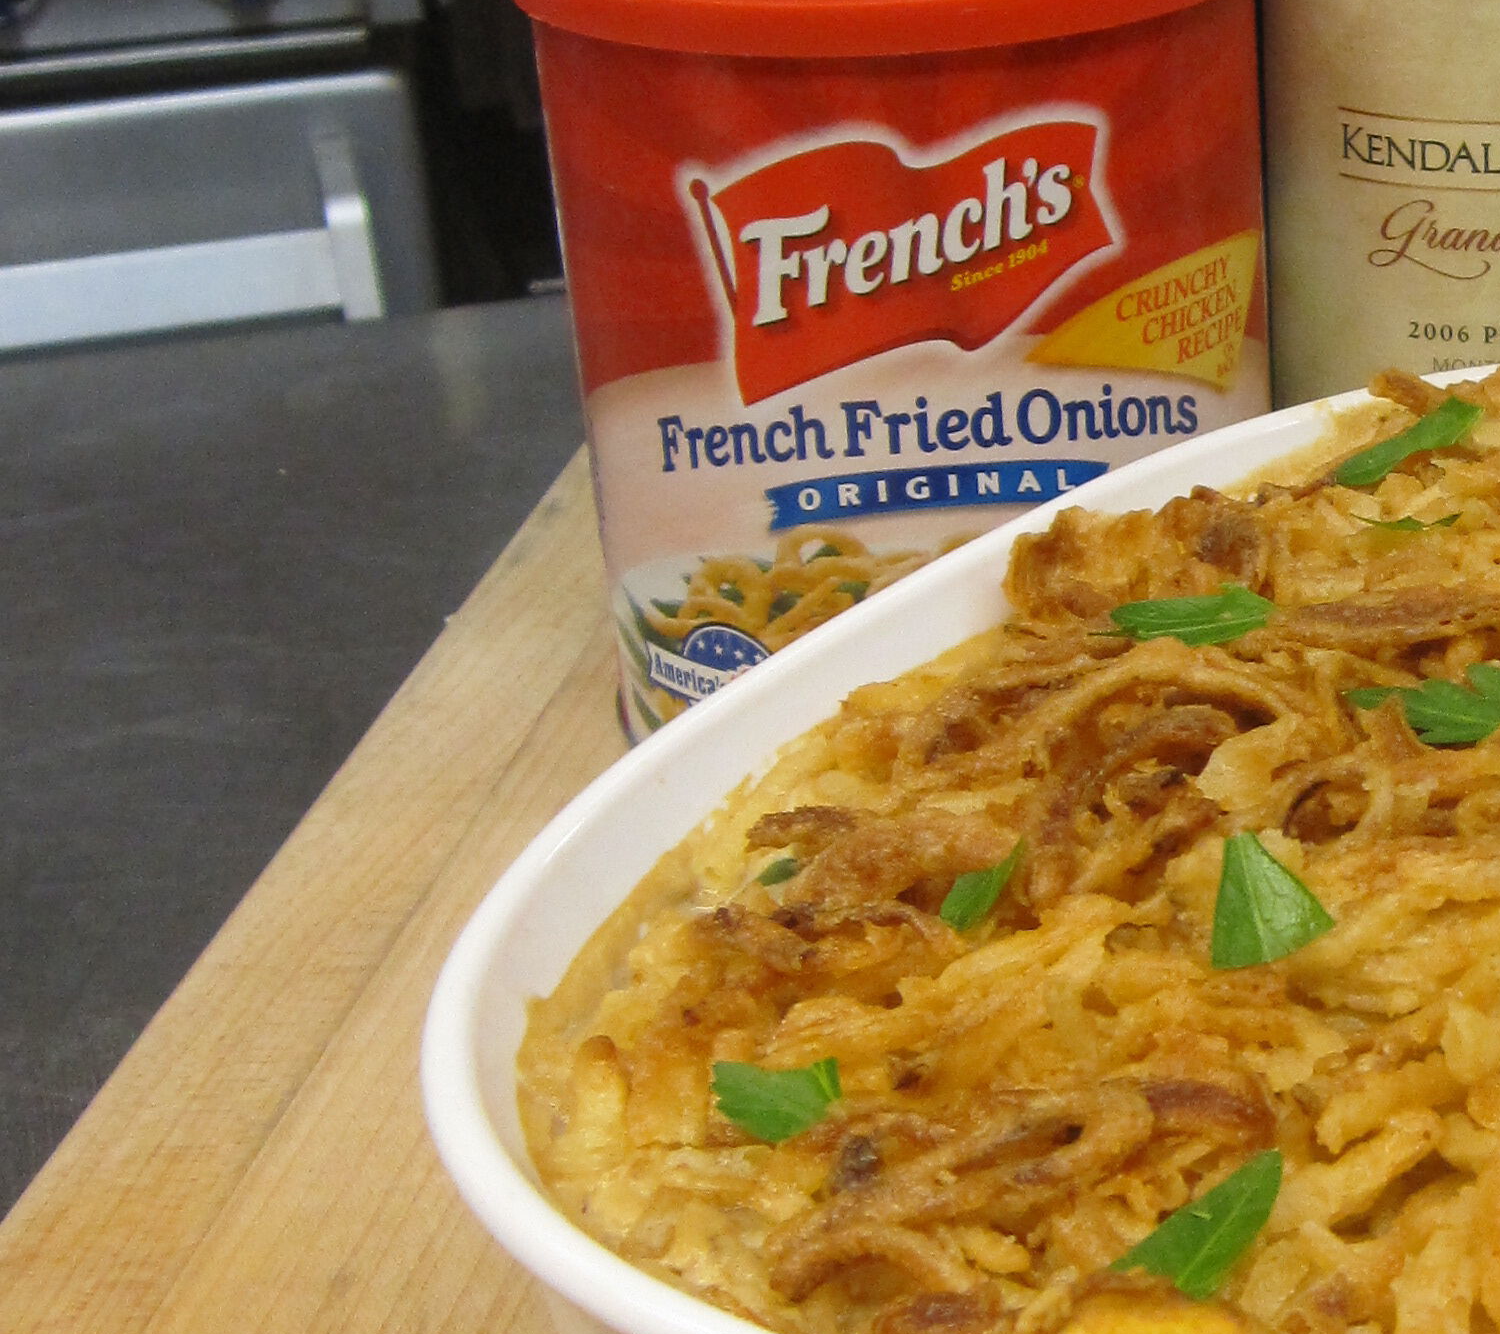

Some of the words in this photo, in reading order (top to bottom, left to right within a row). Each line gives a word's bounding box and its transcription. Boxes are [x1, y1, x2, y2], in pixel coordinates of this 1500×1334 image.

[738, 156, 1073, 327] French's
[950, 261, 1003, 292] Since
[1007, 239, 1049, 269] 1904
[1115, 254, 1231, 323] CRUNCHY
[1142, 281, 1237, 345] CHICKEN
[1176, 307, 1242, 364] RECIPE
[1408, 320, 1470, 343] 2006
[656, 405, 834, 472] French
[841, 391, 1013, 458] Fried
[1016, 383, 1198, 445] Onions
[798, 468, 1077, 511] ORIGINAL
[654, 652, 726, 695] America'
